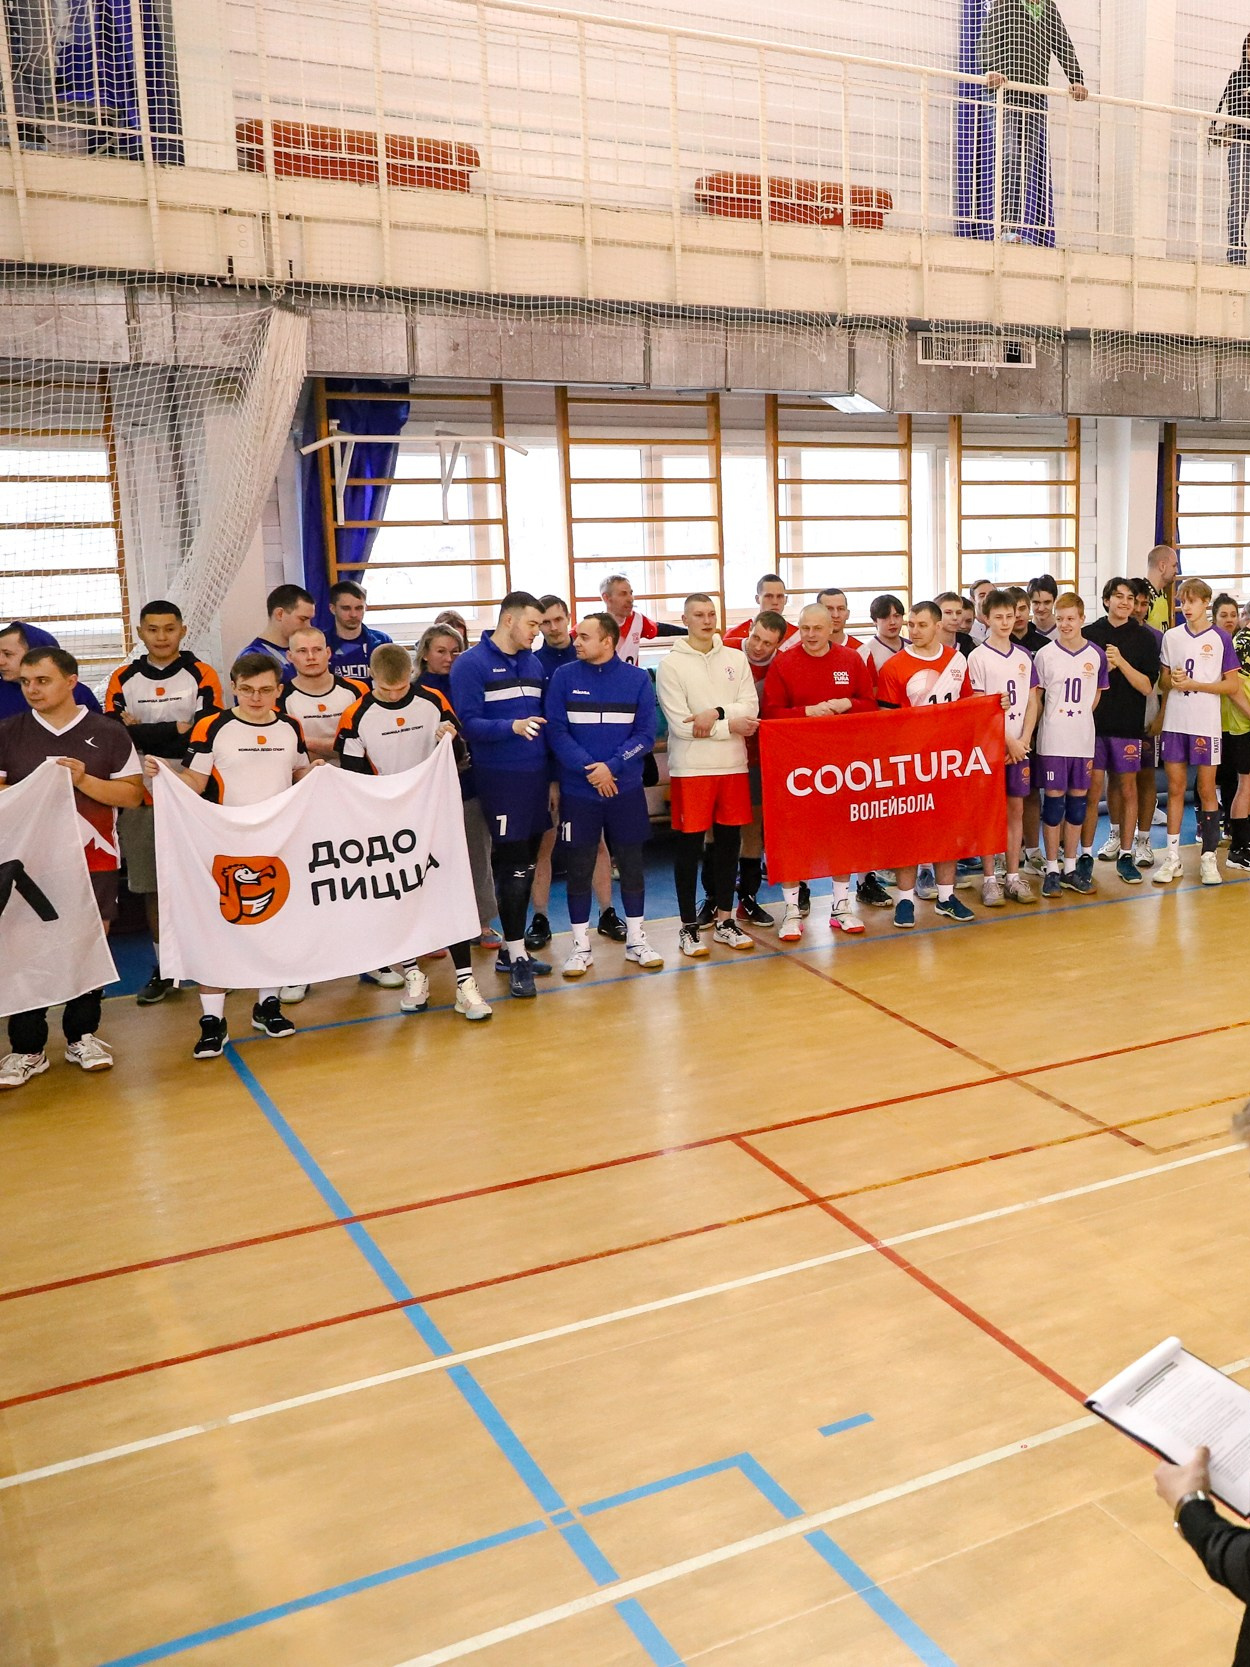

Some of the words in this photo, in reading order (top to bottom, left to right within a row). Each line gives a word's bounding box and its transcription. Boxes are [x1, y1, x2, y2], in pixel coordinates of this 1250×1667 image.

[1064, 677, 1082, 703] 10
[786, 746, 993, 797] COOLTURA
[1046, 771, 1054, 781] 10
[850, 792, 935, 822] ВОЛЕЙБОЛА
[308, 828, 416, 873] ДОДО
[311, 852, 440, 906] ПИЦЦА
